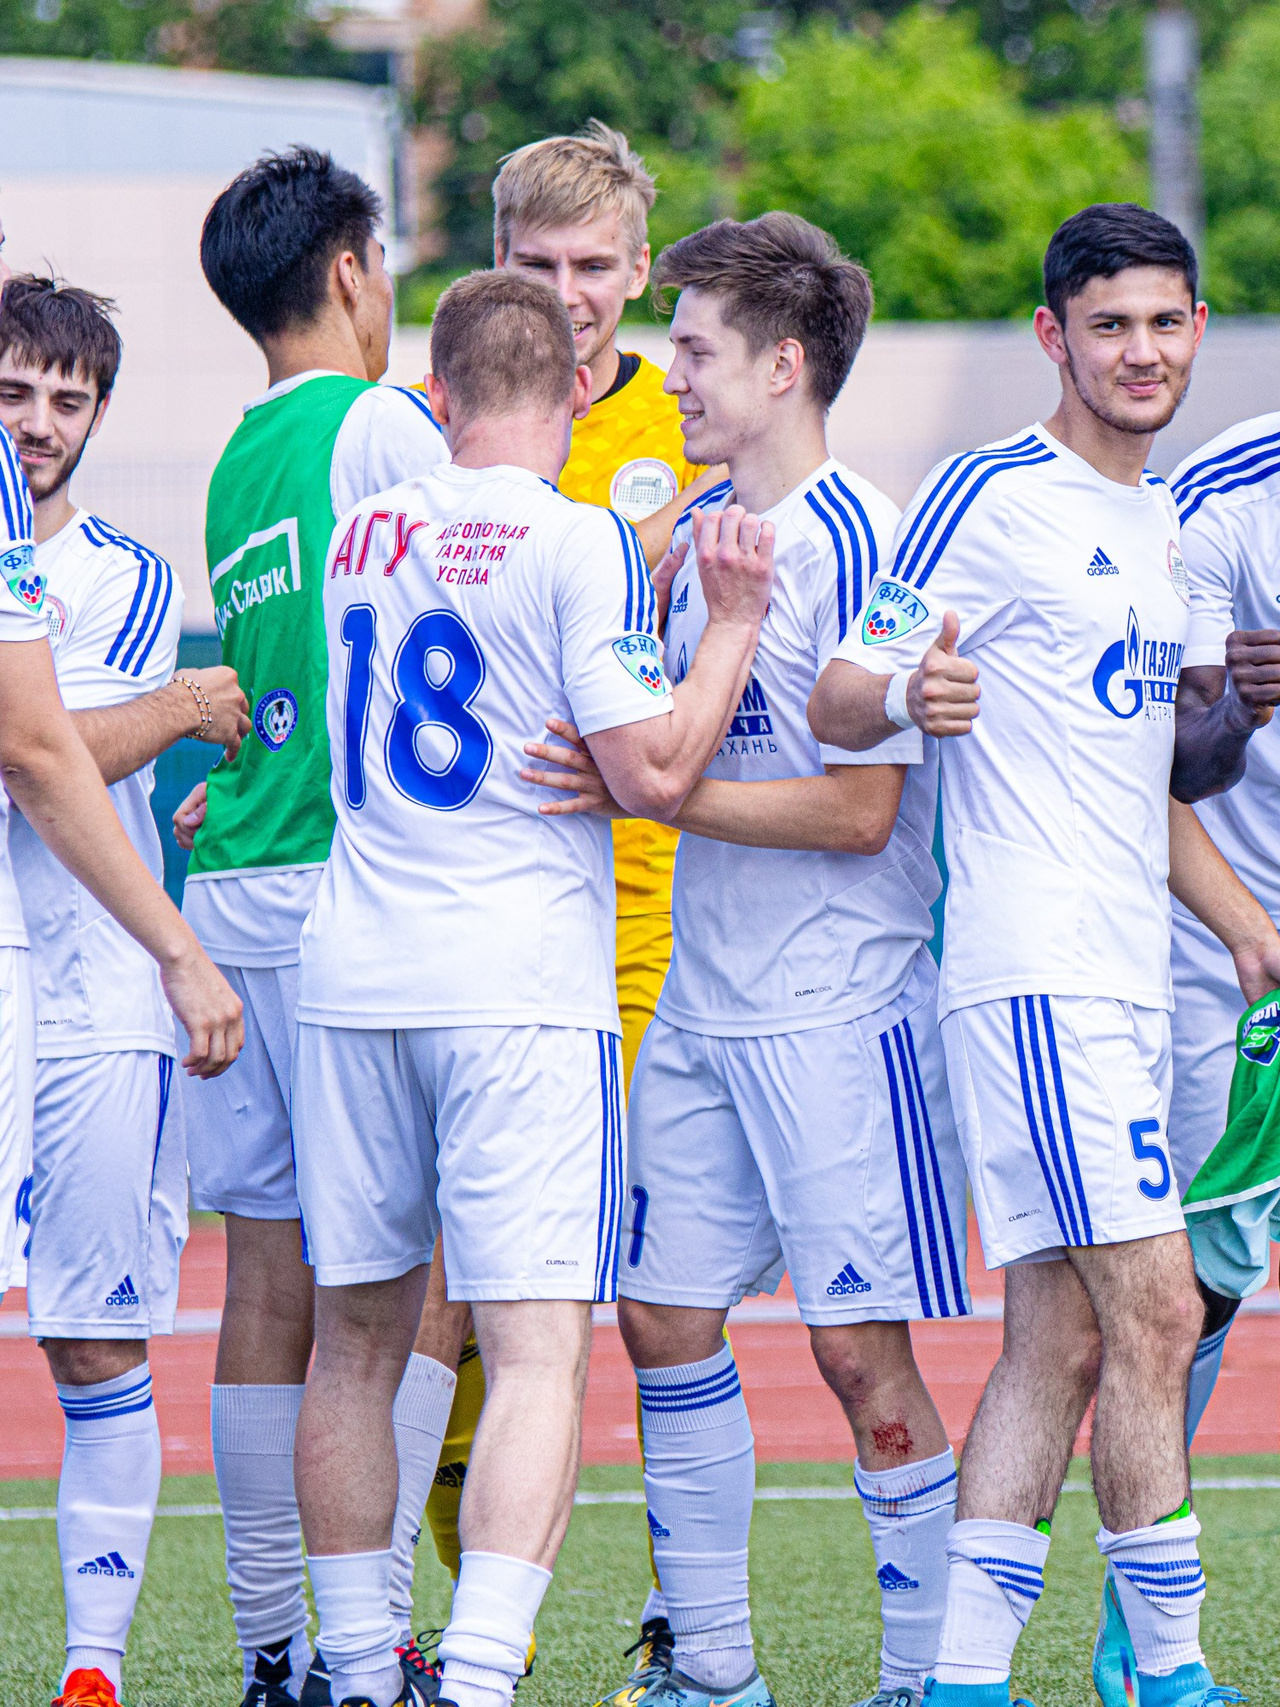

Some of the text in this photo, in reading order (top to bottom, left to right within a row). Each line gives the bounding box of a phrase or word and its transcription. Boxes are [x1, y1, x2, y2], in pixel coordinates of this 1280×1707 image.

[331, 510, 429, 579] АГУ
[436, 564, 489, 585] УСПЕХА
[1087, 564, 1120, 576] adidas
[879, 586, 918, 619] ФНЛ
[340, 603, 493, 811] 18
[795, 985, 833, 997] CLIMACOOL
[1128, 1117, 1171, 1202] 5
[1008, 1208, 1043, 1222] CLIMACOOL
[827, 1283, 872, 1295] adidas
[105, 1294, 139, 1305] adidas
[77, 1565, 134, 1579] adidas
